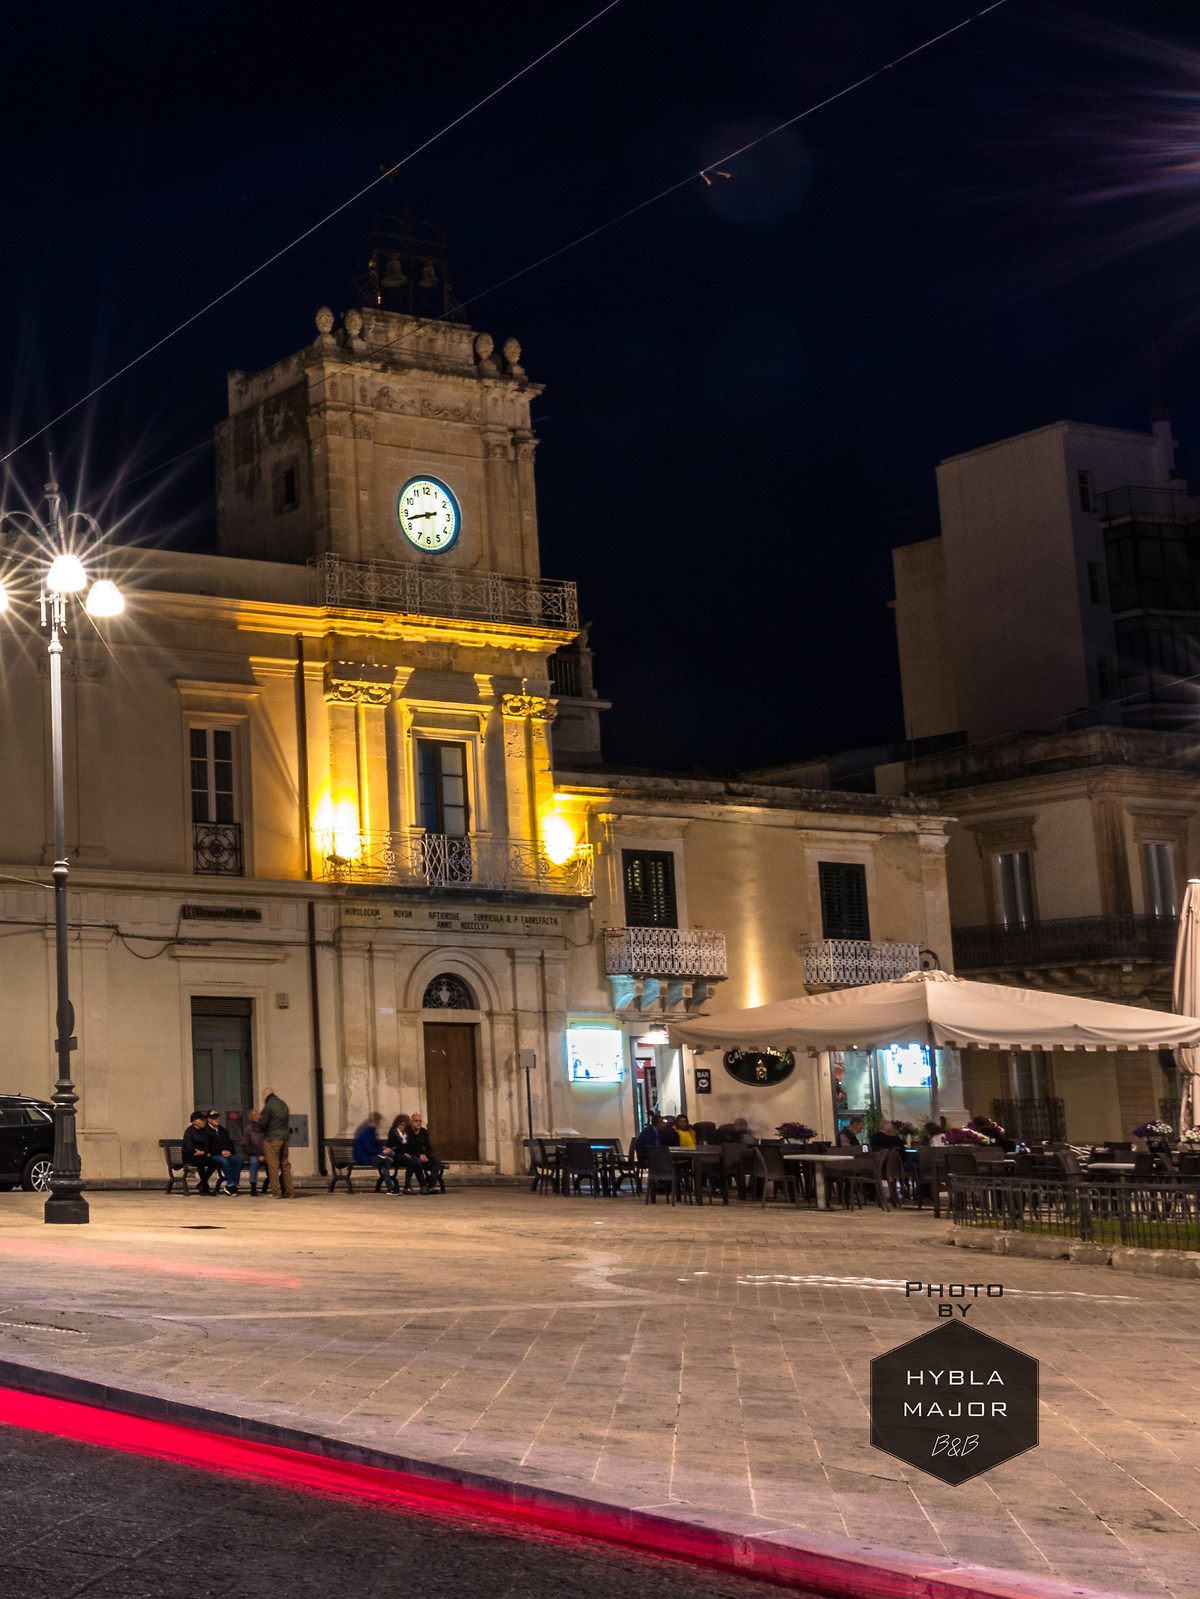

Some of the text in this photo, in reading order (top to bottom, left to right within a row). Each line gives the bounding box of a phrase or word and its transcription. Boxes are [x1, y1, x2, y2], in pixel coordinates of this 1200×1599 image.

[413, 489, 420, 497] 11
[422, 486, 431, 495] 12
[434, 491, 438, 499] 1
[406, 497, 415, 506] 10
[441, 500, 447, 509] 2
[403, 509, 409, 517] 9
[445, 514, 451, 522] 3
[407, 522, 413, 531] 8
[442, 526, 448, 534] 4
[417, 532, 423, 540] 7
[435, 534, 441, 543] 5
[426, 536, 431, 545] 6
[437, 921, 452, 929] ANNO
[696, 1071, 709, 1079] BAR
